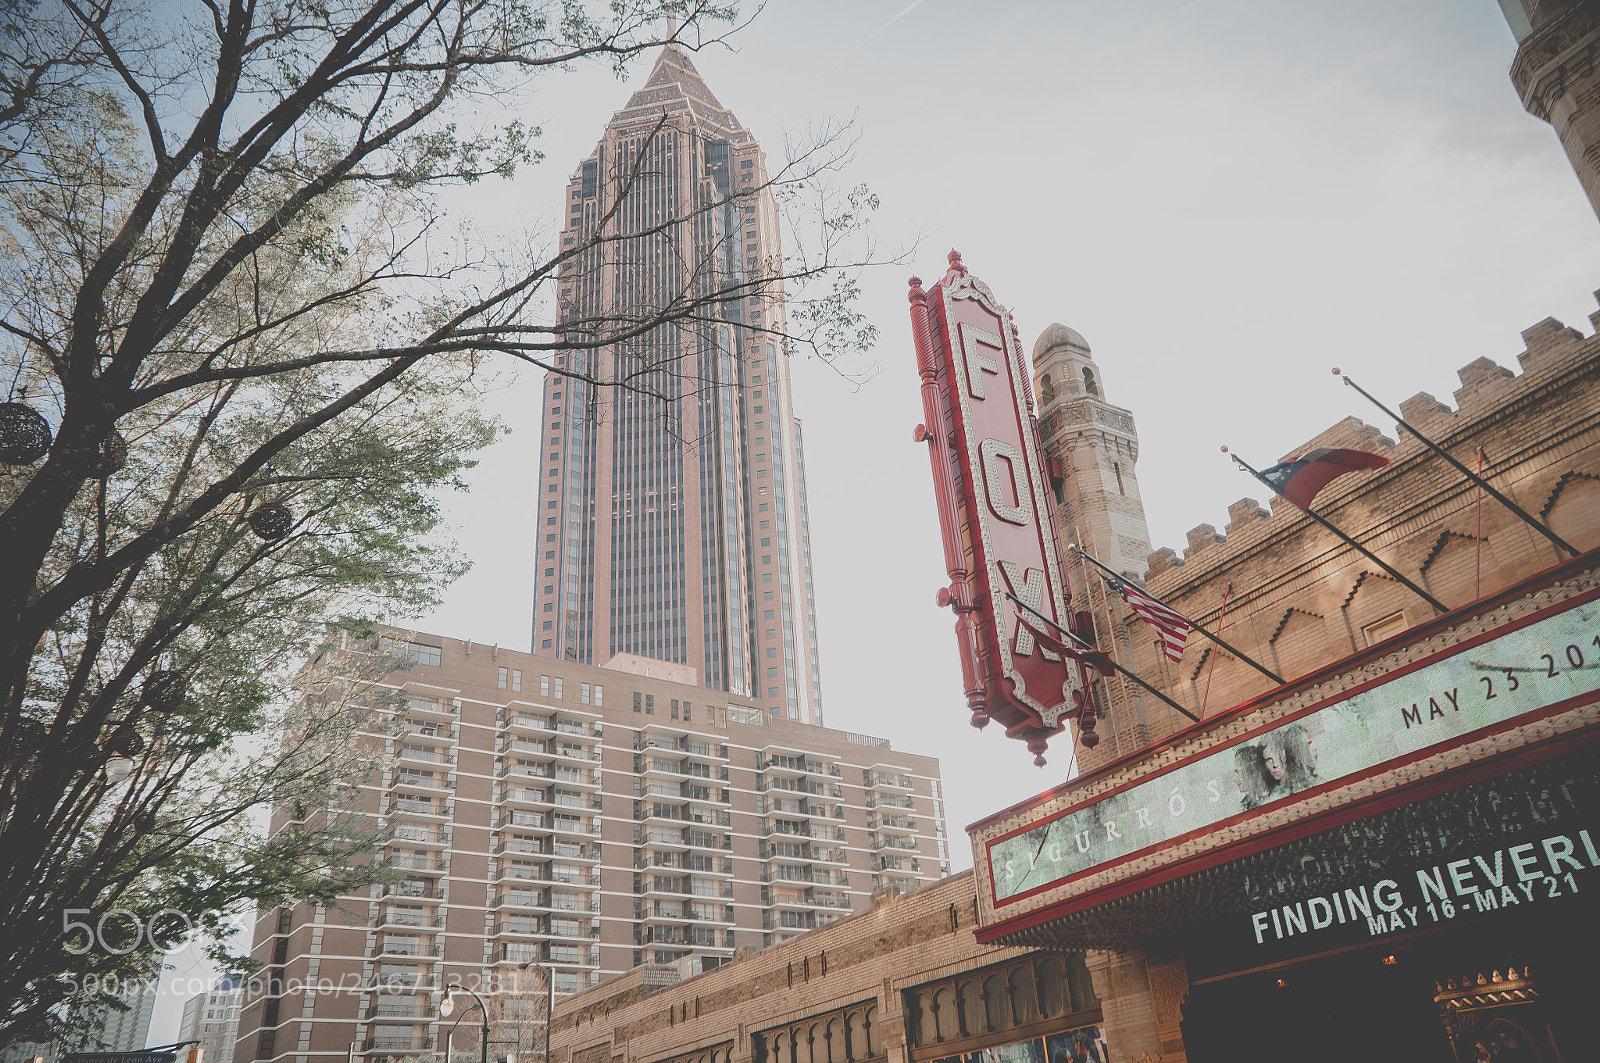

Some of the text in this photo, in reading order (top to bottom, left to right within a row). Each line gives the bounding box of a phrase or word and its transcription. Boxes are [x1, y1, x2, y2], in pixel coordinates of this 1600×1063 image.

[957, 320, 1061, 663] FOX
[1401, 687, 1459, 729] MAY
[1480, 666, 1519, 701] 23
[1251, 878, 1403, 944] FINDING
[1366, 905, 1419, 936] MAY
[1426, 899, 1456, 922] 16
[1473, 880, 1535, 913] MAY
[1543, 871, 1579, 898] 21
